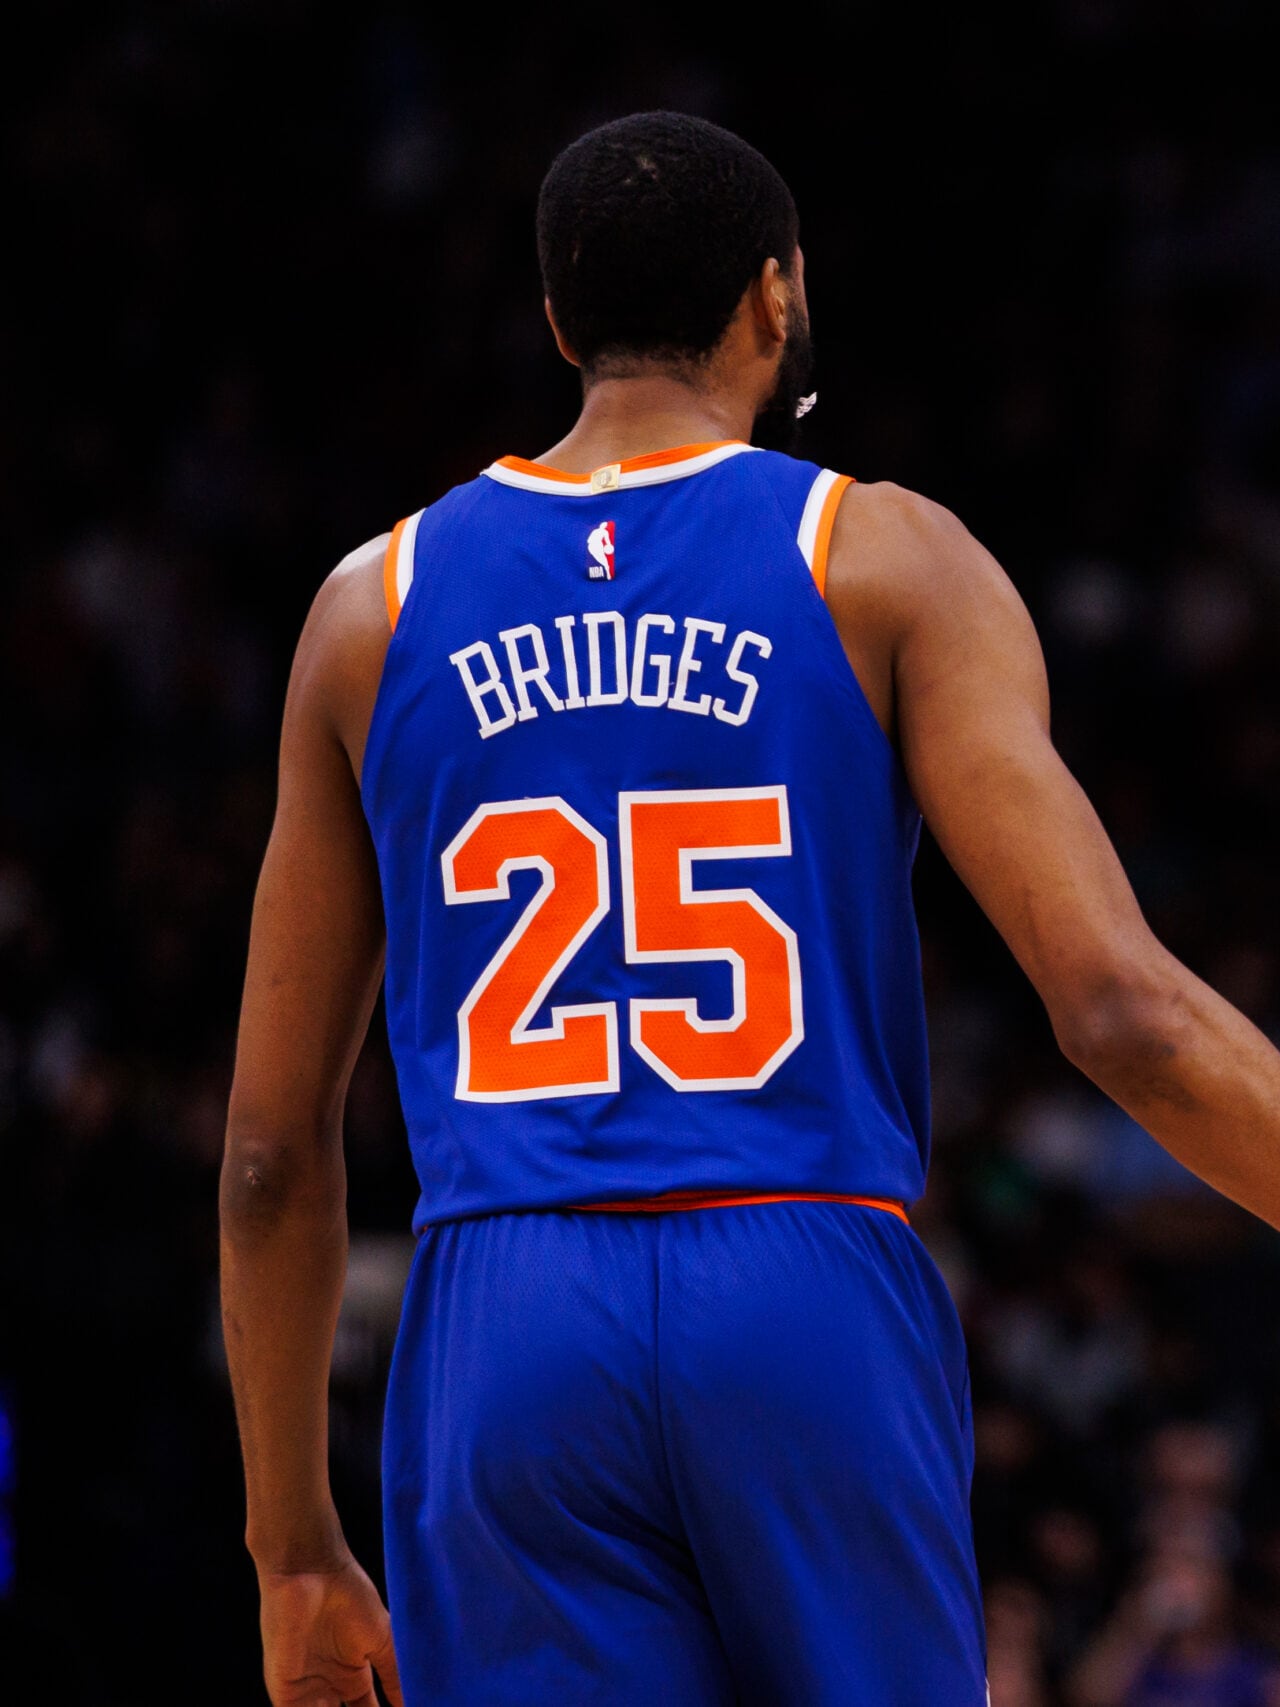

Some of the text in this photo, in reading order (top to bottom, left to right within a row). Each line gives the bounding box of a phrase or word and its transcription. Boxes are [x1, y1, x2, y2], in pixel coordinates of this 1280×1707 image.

[589, 565, 605, 578] NBA
[449, 611, 773, 739] BRIDGES
[441, 785, 804, 1103] 25
